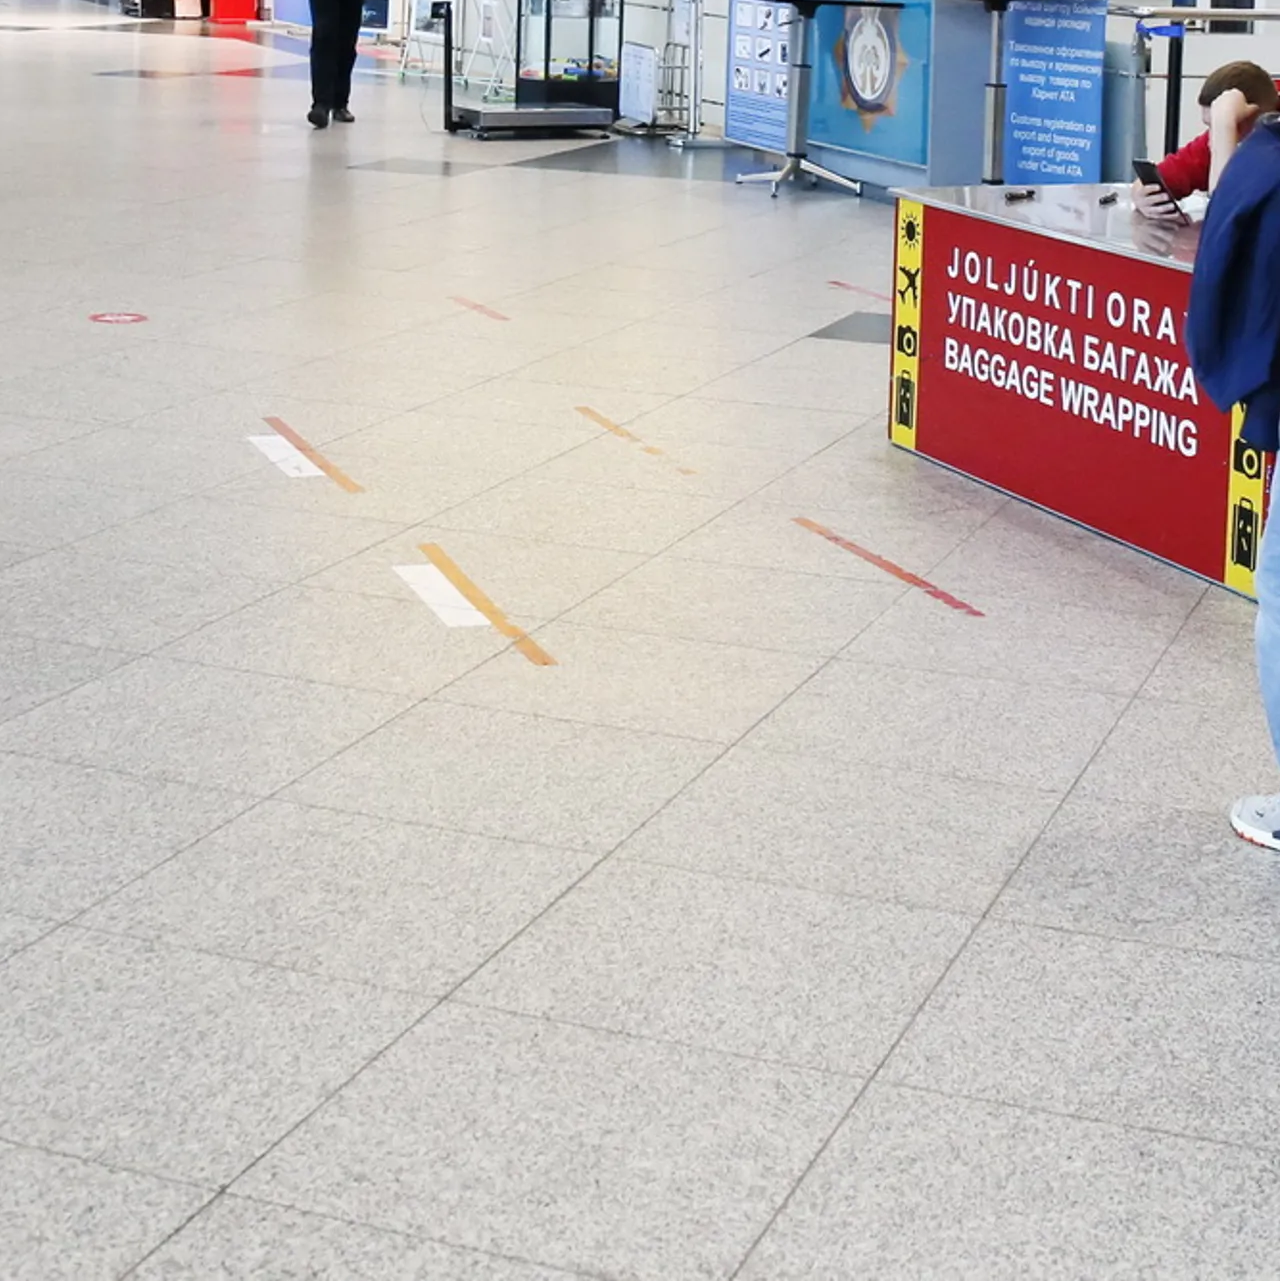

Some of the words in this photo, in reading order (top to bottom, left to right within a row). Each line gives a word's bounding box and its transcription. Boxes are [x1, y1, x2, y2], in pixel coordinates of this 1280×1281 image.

[1010, 111, 1042, 127] Customs
[1043, 117, 1085, 133] registration
[1085, 123, 1097, 133] on
[1013, 129, 1037, 141] export
[1037, 131, 1052, 143] and
[1052, 133, 1092, 151] temporary
[1022, 145, 1046, 157] export
[1046, 147, 1055, 158] of
[1055, 150, 1080, 163] goods
[1017, 159, 1039, 171] under
[1039, 160, 1066, 175] Carnet
[1066, 164, 1083, 177] ATA
[947, 246, 1095, 320] JOLJÚKTI
[1106, 290, 1188, 346] ORA
[947, 290, 1076, 365] УПАКОВКА
[1082, 333, 1199, 407] БАГАЖА
[944, 335, 1055, 408] BAGGAGE
[1059, 375, 1199, 458] WRAPPING
